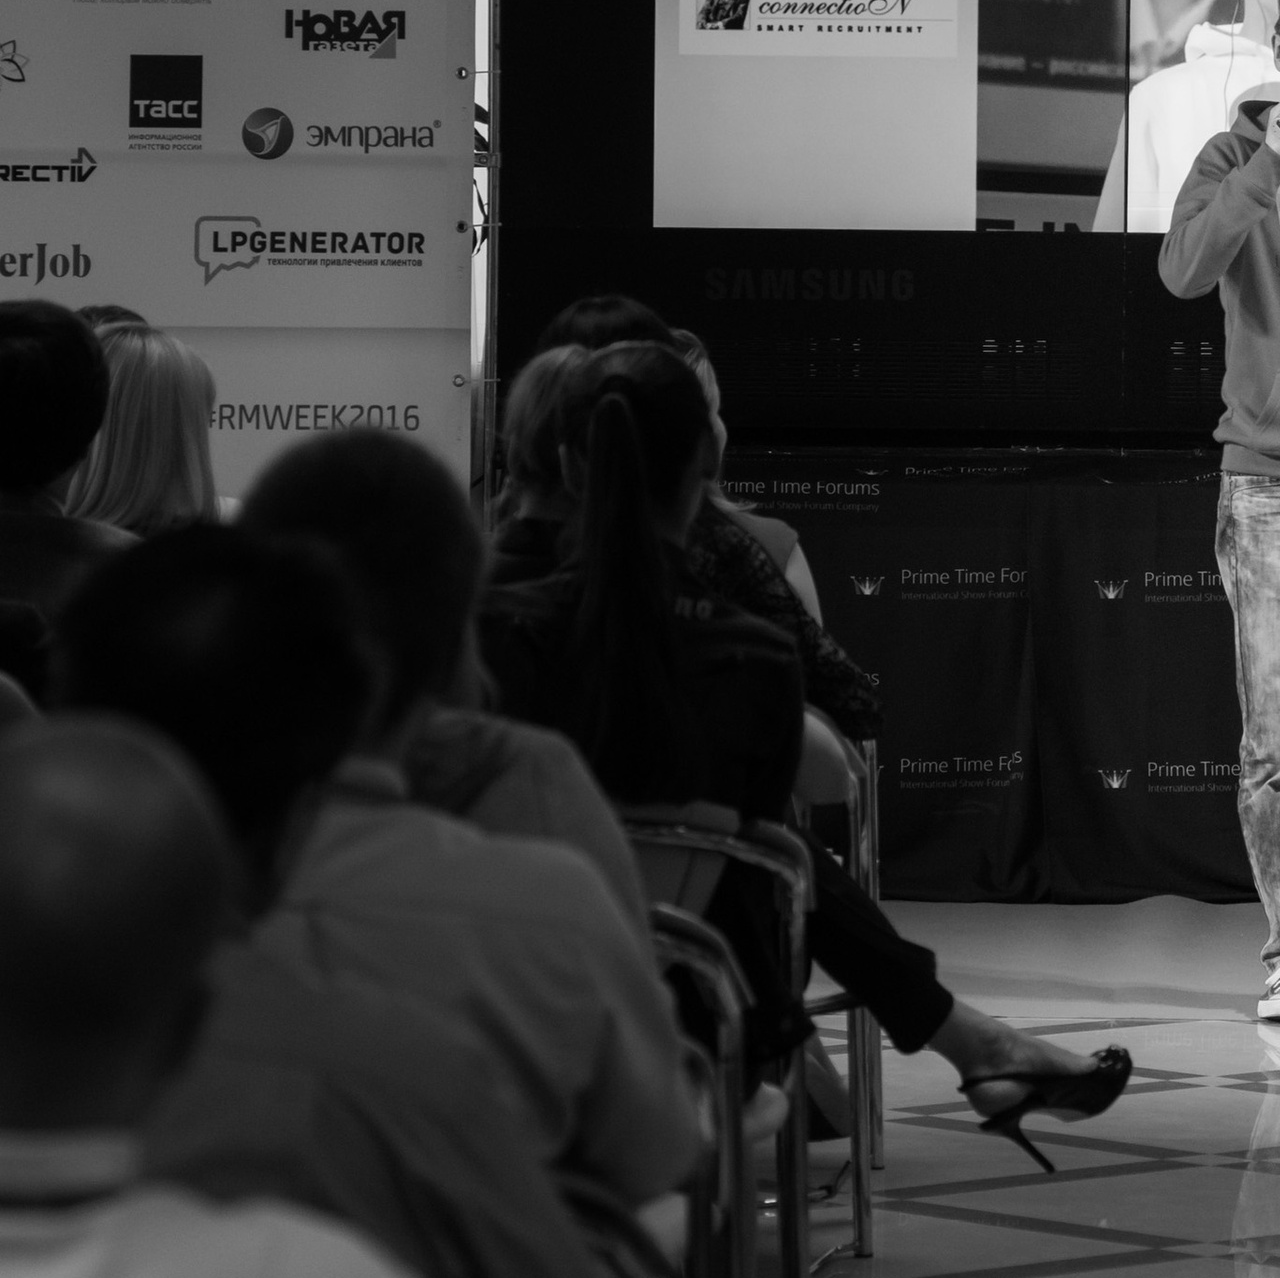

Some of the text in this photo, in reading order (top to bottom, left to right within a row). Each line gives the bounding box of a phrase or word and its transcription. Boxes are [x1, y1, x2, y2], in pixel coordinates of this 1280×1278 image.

[757, 25, 924, 34] SMART RECRUITMENT
[213, 231, 425, 254] LPGENERATOR
[0, 243, 92, 286] erJob
[267, 258, 424, 268] технологии привлечения клиентов
[705, 268, 915, 301] SAMSUNG
[901, 570, 950, 584] Prime
[954, 568, 995, 583] Time
[1144, 571, 1193, 587] Prime
[900, 758, 949, 774] Prime
[953, 757, 994, 772] Time
[1148, 761, 1241, 777] Prime Time
